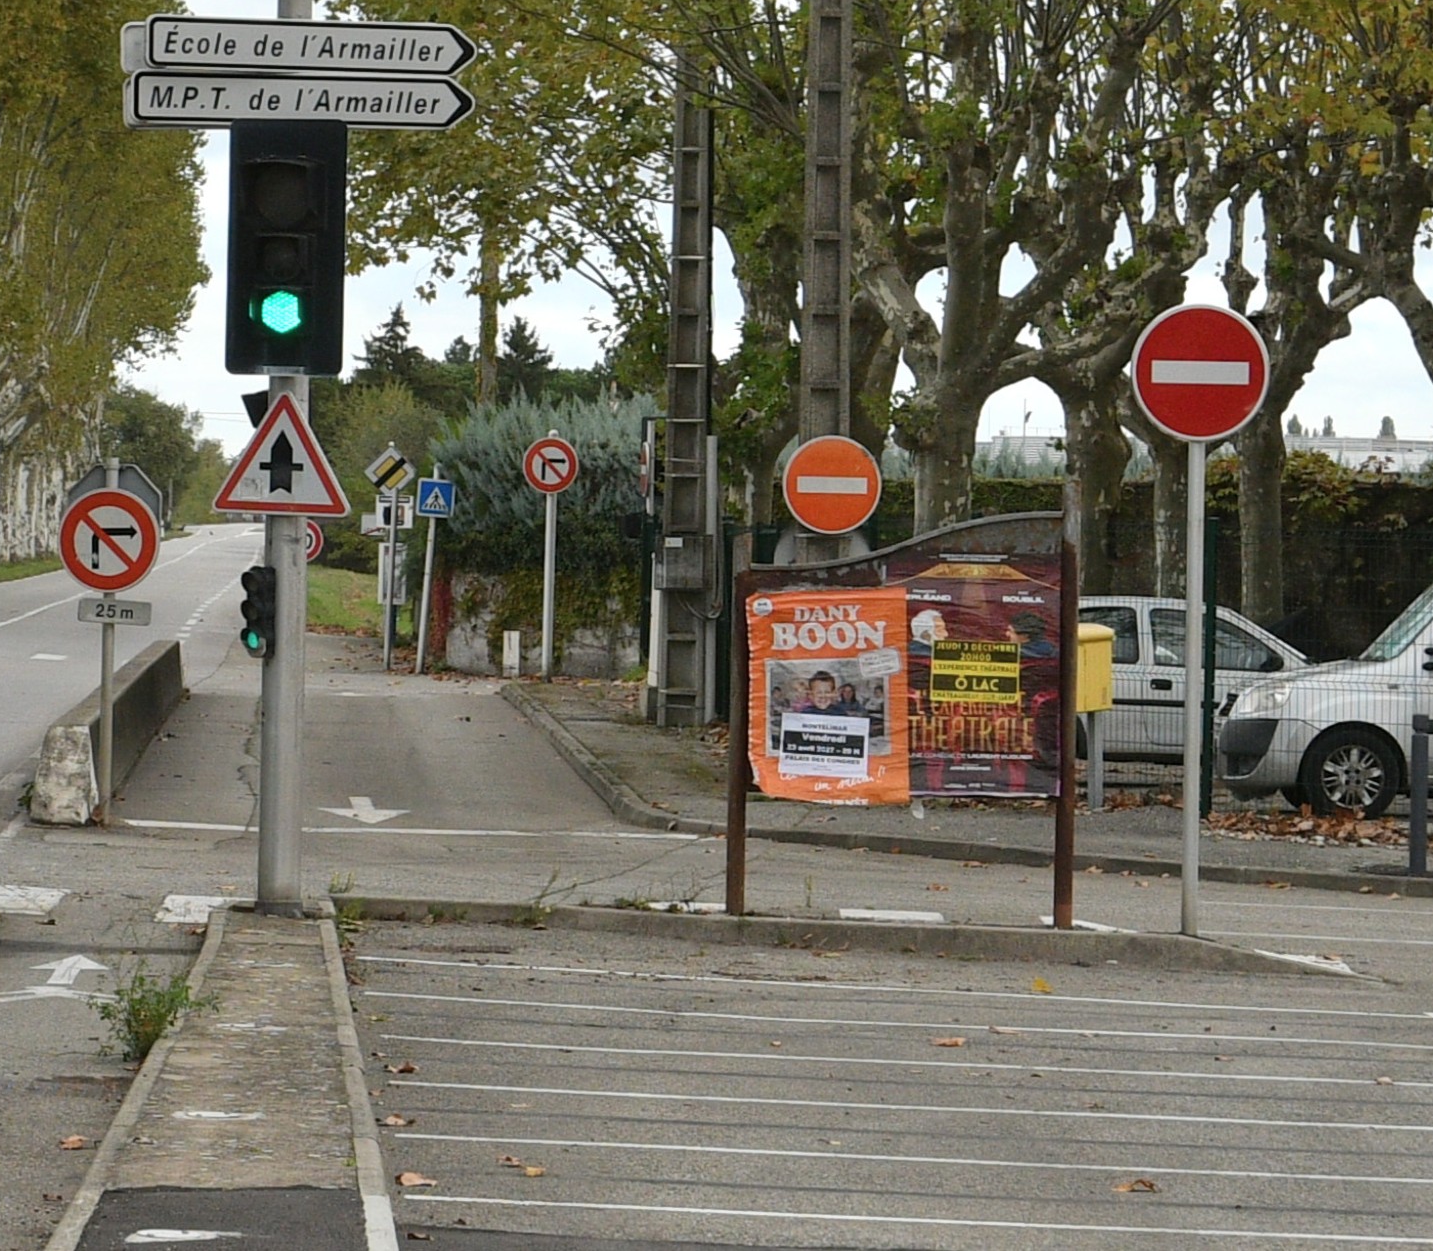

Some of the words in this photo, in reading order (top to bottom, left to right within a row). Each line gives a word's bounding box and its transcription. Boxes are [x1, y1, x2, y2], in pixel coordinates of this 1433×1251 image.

[164, 25, 236, 56] École
[253, 34, 284, 58] de
[300, 34, 444, 62] l'Armailler
[149, 86, 230, 110] M.P.T.
[249, 88, 280, 112] de
[295, 88, 440, 115] l'Armailler
[95, 603, 117, 618] 25
[120, 608, 134, 619] m
[794, 605, 861, 622] DANY
[771, 621, 887, 650] BOON
[936, 641, 961, 650] JEUDI
[960, 652, 992, 661] 20H00
[972, 678, 999, 691] LAC
[802, 733, 847, 744] Vendredi
